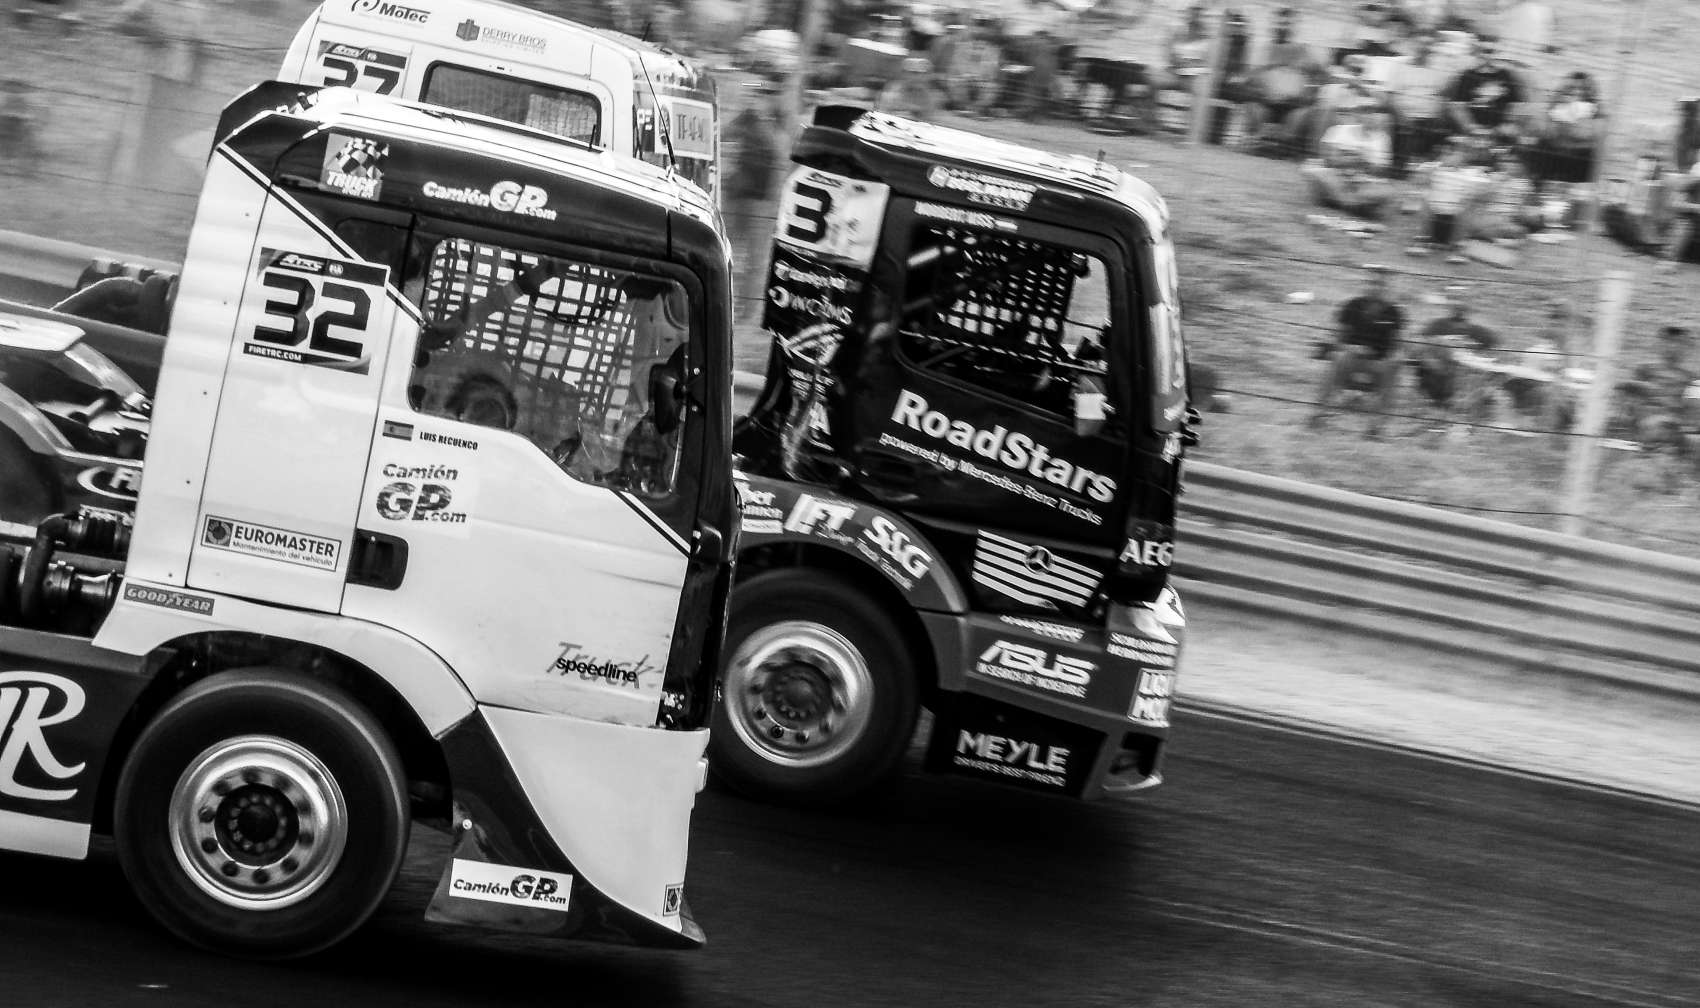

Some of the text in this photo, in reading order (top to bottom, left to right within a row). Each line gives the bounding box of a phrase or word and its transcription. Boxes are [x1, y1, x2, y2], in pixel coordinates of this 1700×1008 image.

[253, 271, 371, 359] 32
[419, 431, 479, 451] LUIS RECUENCO
[891, 388, 1117, 503] RoadStars
[235, 525, 335, 558] EUROMASTER
[556, 657, 638, 683] speedline
[979, 640, 1096, 686] ASUS
[956, 729, 1070, 775] MEYLE
